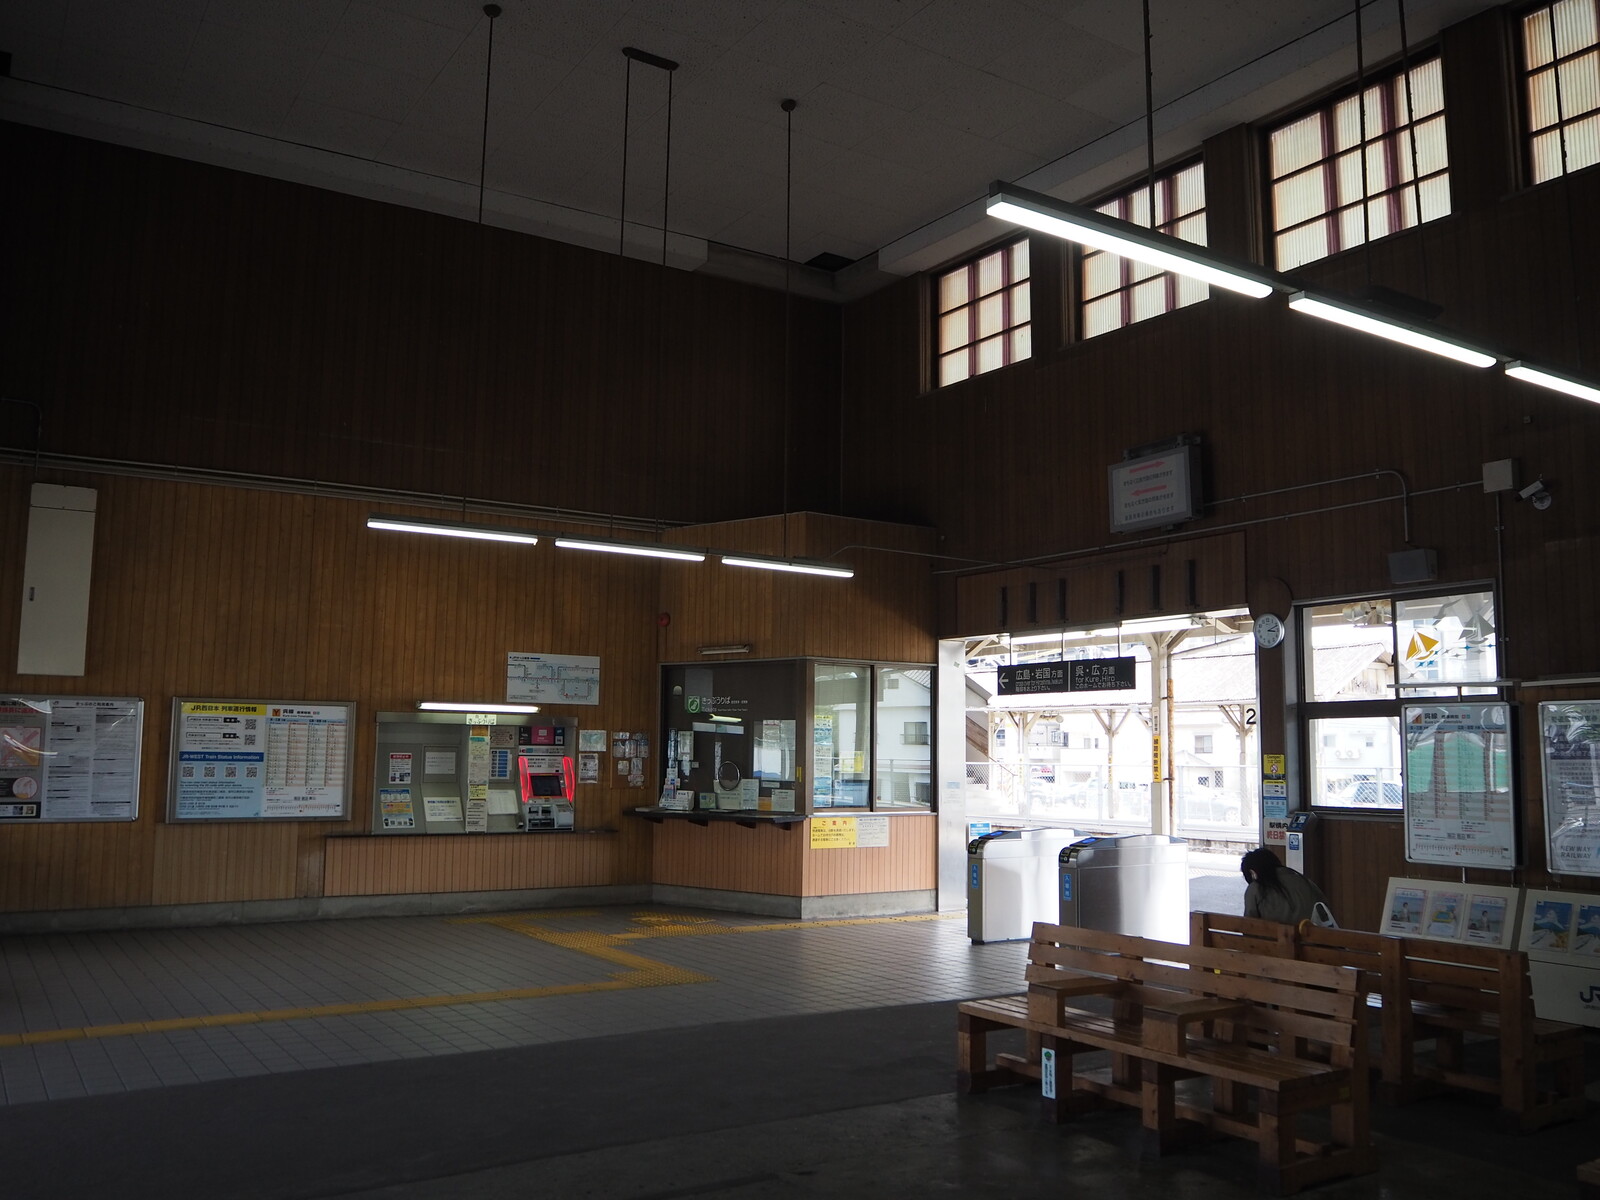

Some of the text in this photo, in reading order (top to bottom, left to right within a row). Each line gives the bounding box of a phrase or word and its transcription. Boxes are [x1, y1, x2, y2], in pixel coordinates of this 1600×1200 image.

[1016, 668, 1063, 680] 広島・岩国方面
[1076, 664, 1115, 676] 呉・広方面
[1246, 708, 1256, 724] 2
[1267, 831, 1287, 840] 終日禁
